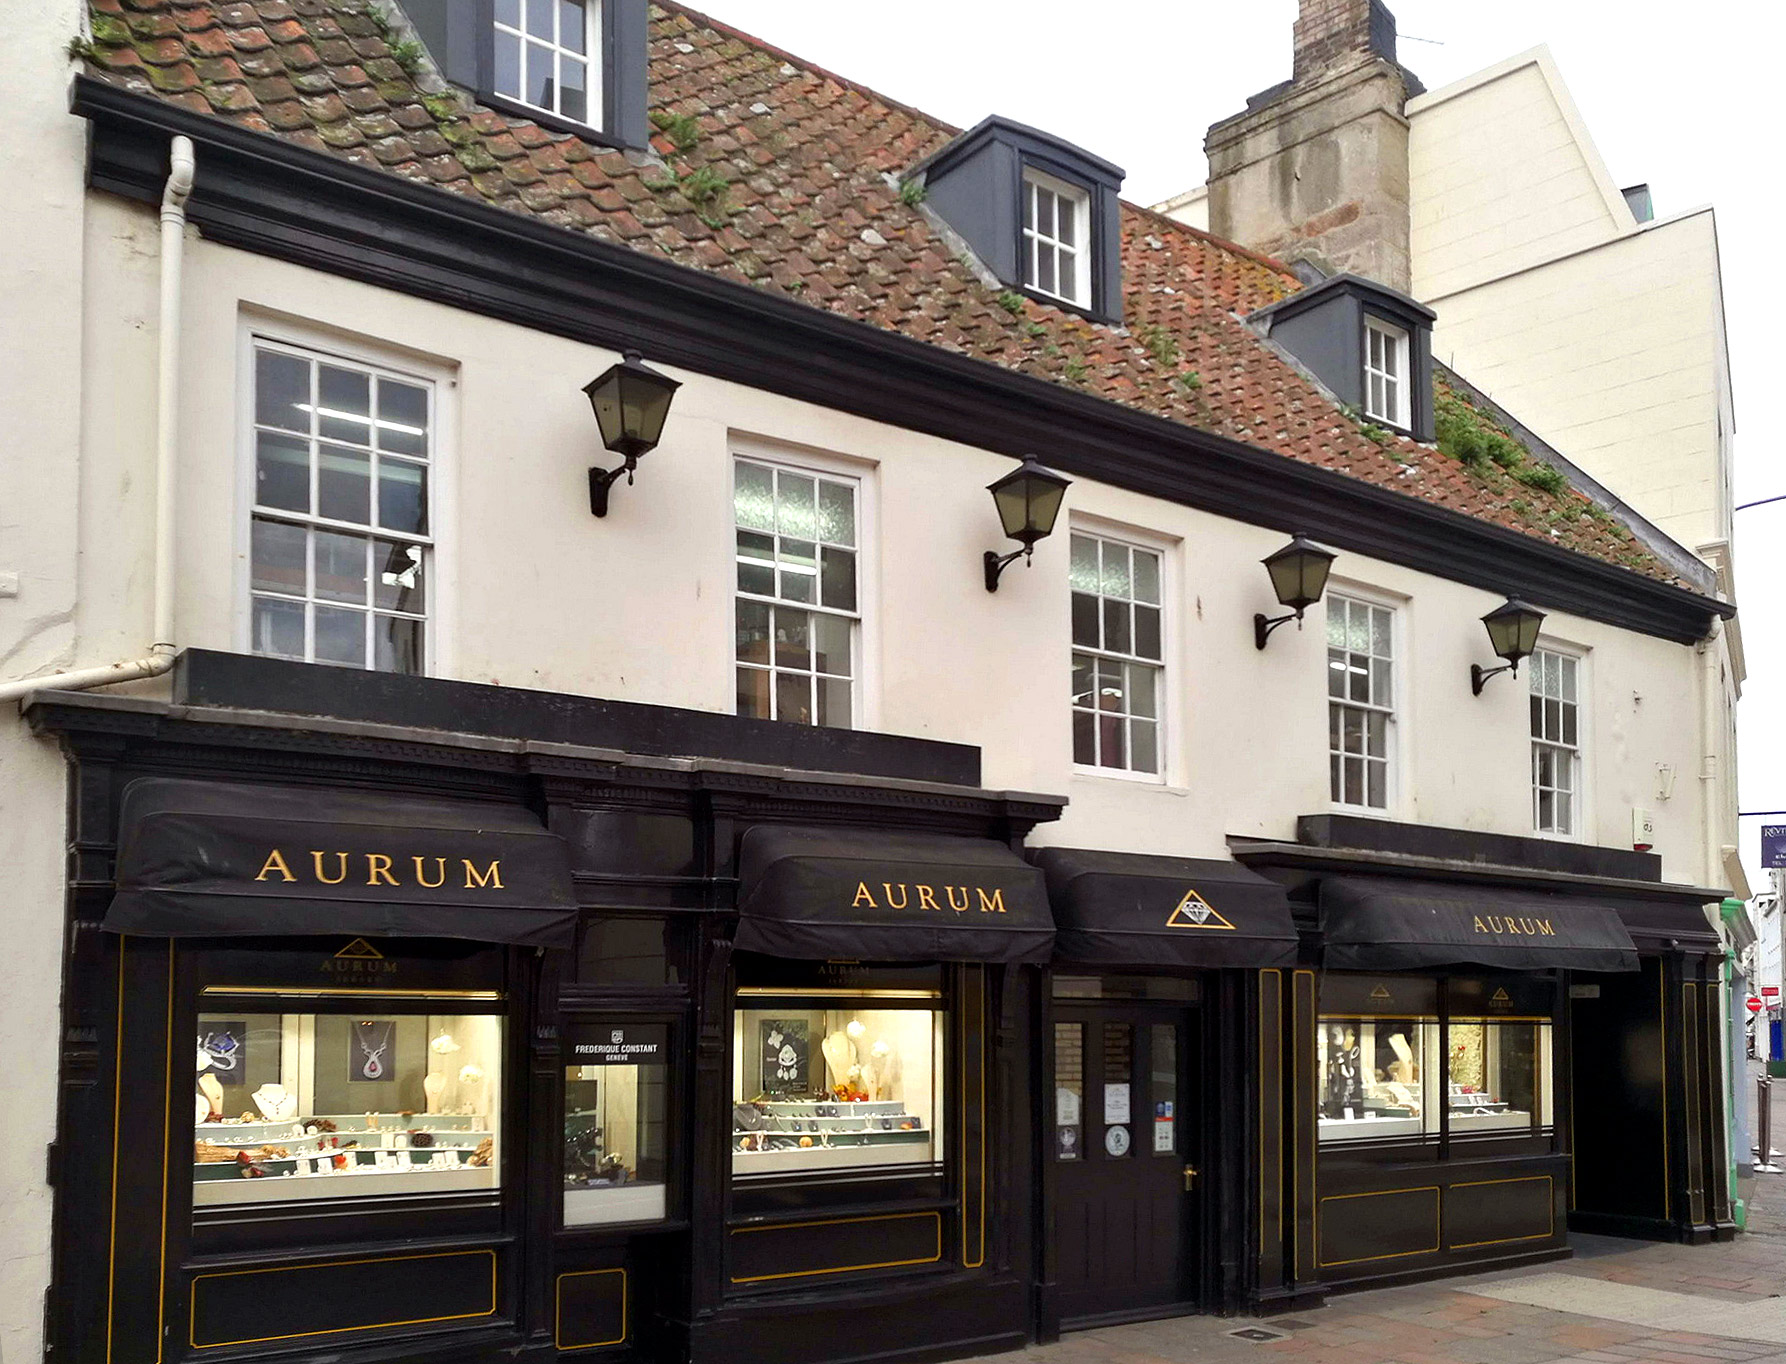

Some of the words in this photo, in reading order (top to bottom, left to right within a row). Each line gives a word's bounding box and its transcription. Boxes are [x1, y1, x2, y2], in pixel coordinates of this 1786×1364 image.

[254, 848, 504, 889] AURUM
[851, 880, 1007, 914] AURUM
[1472, 914, 1555, 938] AURUM
[575, 1044, 620, 1054] FREDERIQUE
[620, 1043, 658, 1054] CONSTANT
